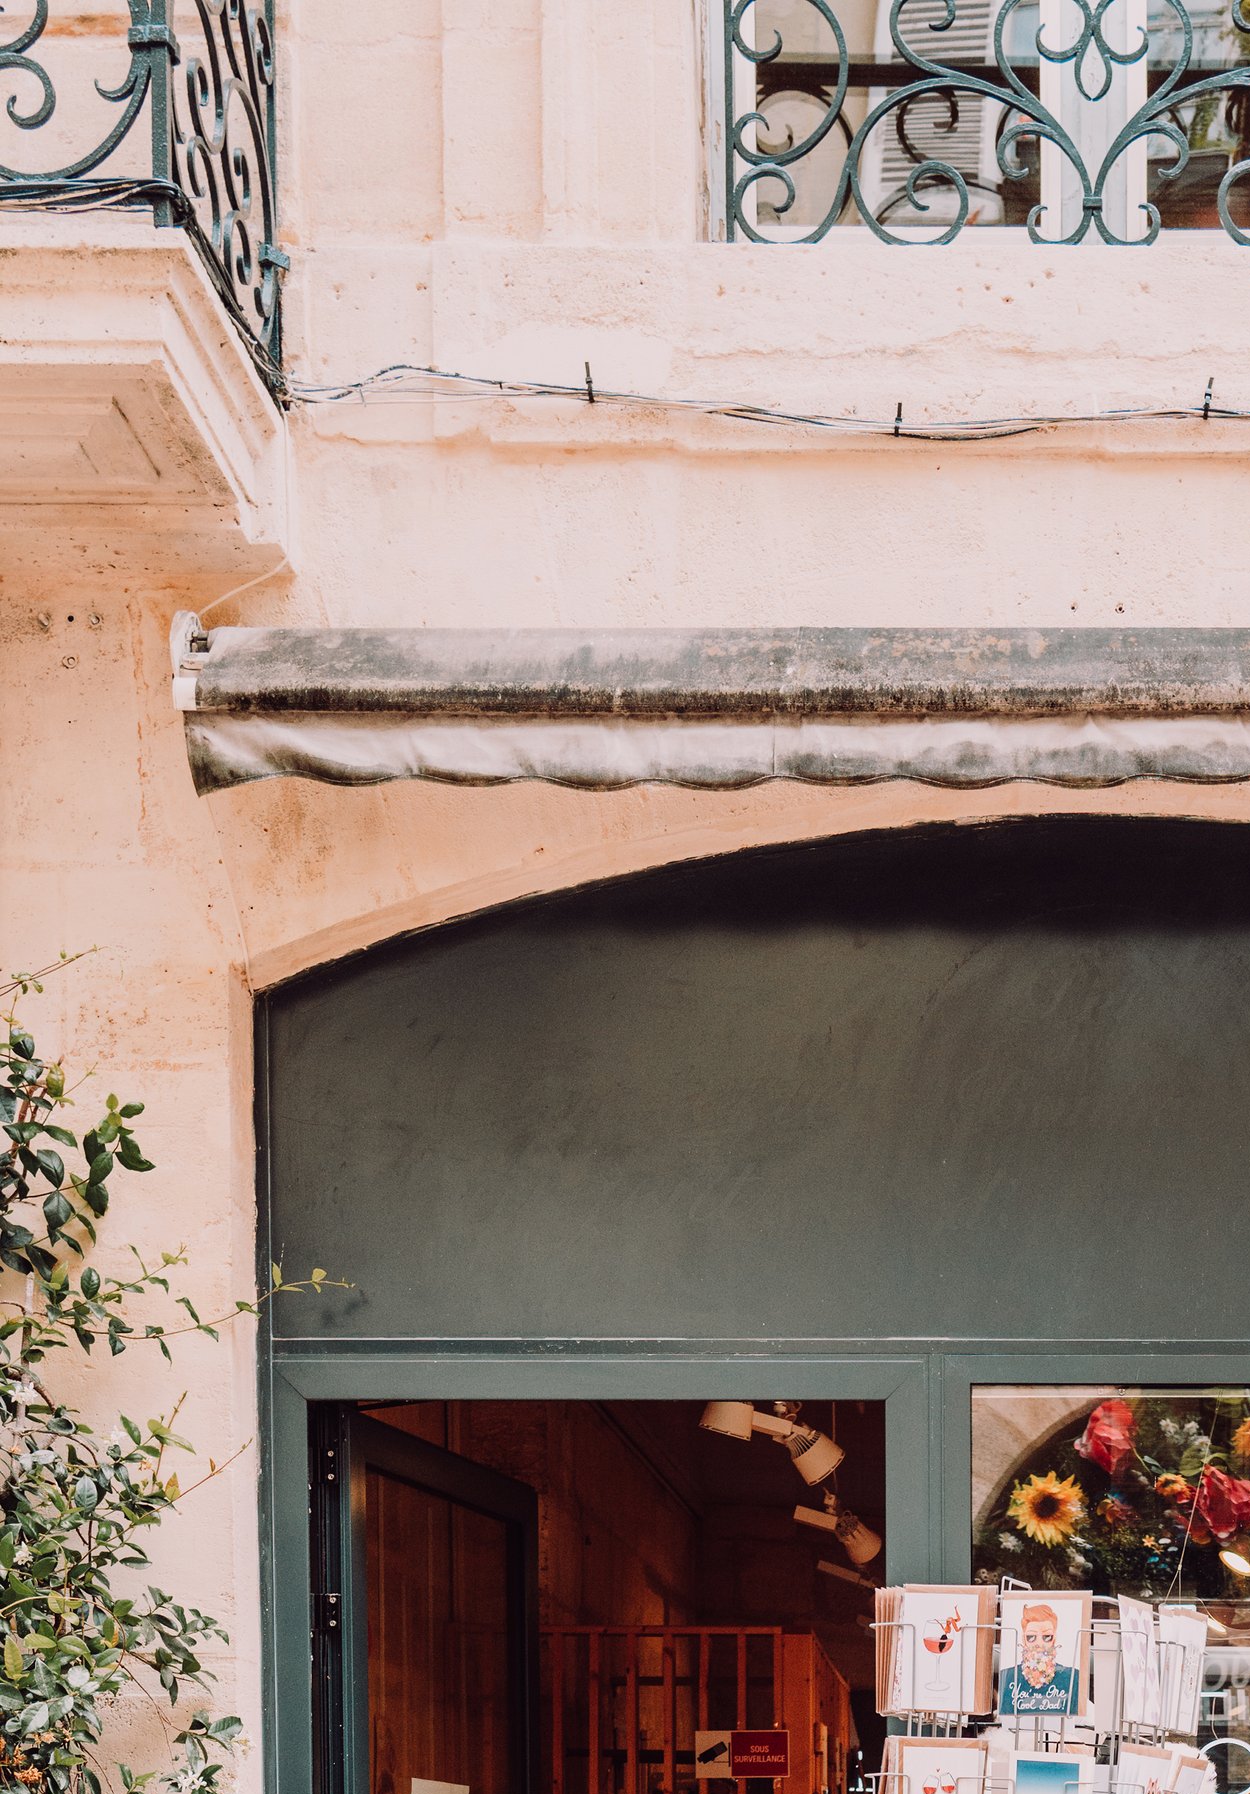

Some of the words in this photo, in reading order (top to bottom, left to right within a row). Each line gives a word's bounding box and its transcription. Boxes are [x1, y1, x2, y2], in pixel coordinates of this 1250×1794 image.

[1046, 1685, 1067, 1698] One
[1039, 1699, 1066, 1710] Dad!
[750, 1745, 769, 1753] SOUS
[734, 1754, 786, 1763] SURVEILLANCE
